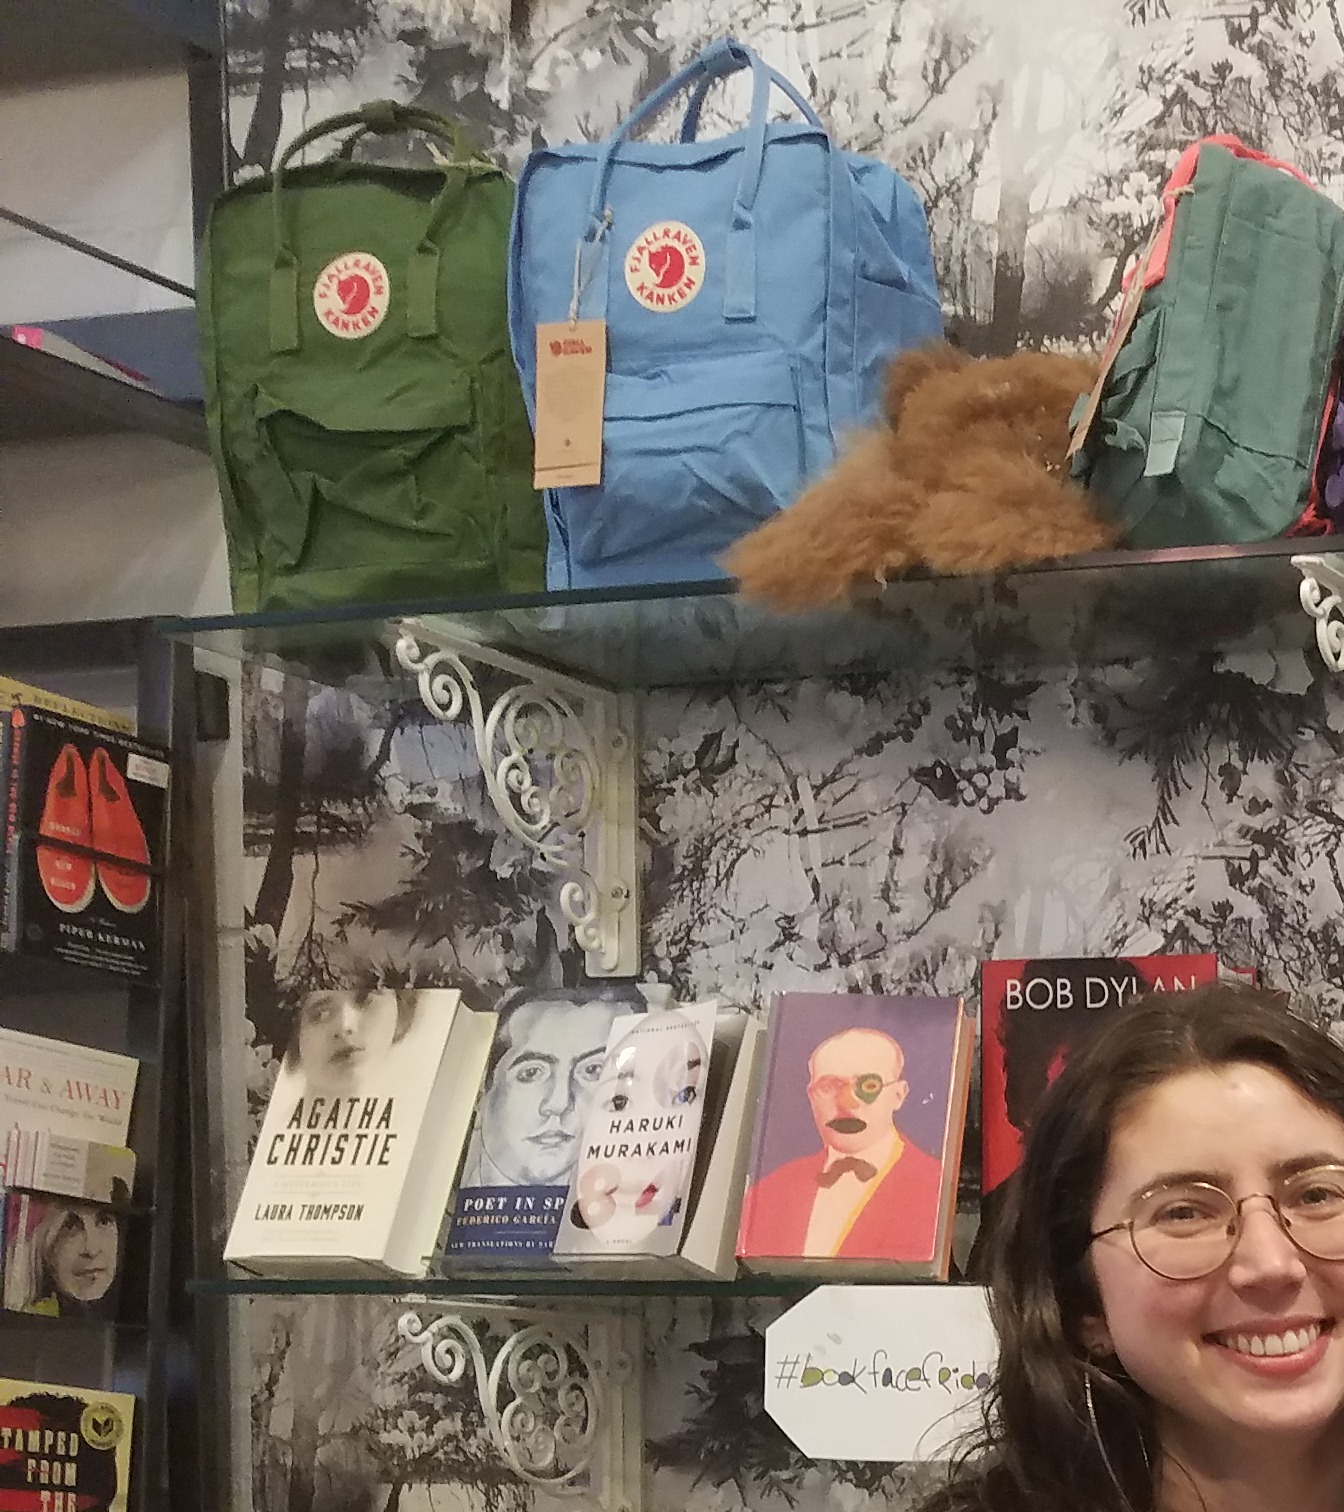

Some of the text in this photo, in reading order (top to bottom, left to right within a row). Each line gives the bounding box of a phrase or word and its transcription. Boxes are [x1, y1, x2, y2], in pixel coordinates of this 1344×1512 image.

[1006, 977, 1074, 1010] BOB
[0, 1066, 32, 1090] AR
[59, 1080, 126, 1111] AWAY
[286, 1097, 395, 1130] AGATHA
[609, 1114, 684, 1134] HARUKI
[266, 1133, 398, 1166] CHRISTIE
[586, 1138, 692, 1160] MURAKAMI
[254, 1203, 365, 1221] LAURA THOMPSON
[463, 1196, 507, 1212] POET
[514, 1196, 536, 1211] IN
[0, 1427, 79, 1457] TAMPED
[27, 1458, 77, 1487] FROM
